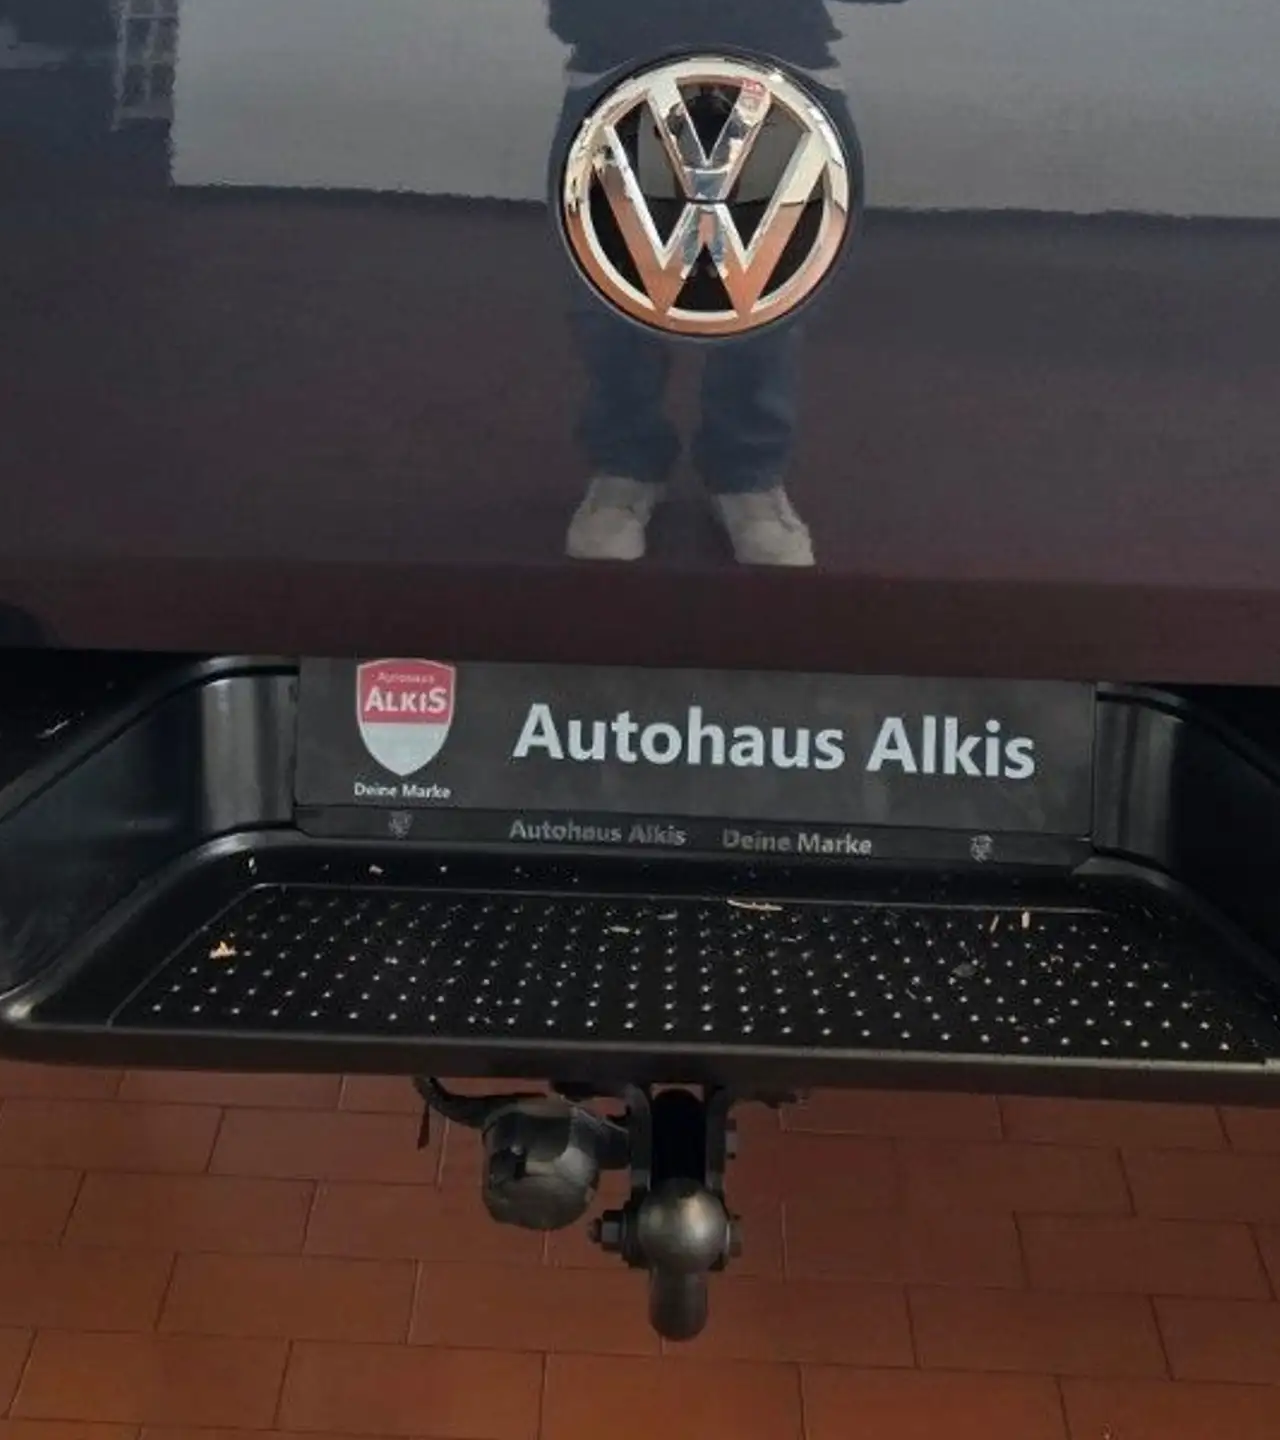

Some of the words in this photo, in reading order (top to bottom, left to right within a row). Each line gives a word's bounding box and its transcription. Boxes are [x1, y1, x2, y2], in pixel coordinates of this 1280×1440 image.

[363, 685, 449, 714] ALKIS
[512, 702, 846, 771] Autohaus
[865, 714, 1037, 779] Alkis
[353, 781, 398, 798] Deine
[402, 783, 452, 799] Marke
[509, 818, 622, 843] Autohaus
[627, 823, 688, 847] Alkis
[721, 828, 792, 852] Deine
[796, 832, 873, 856] Marke
